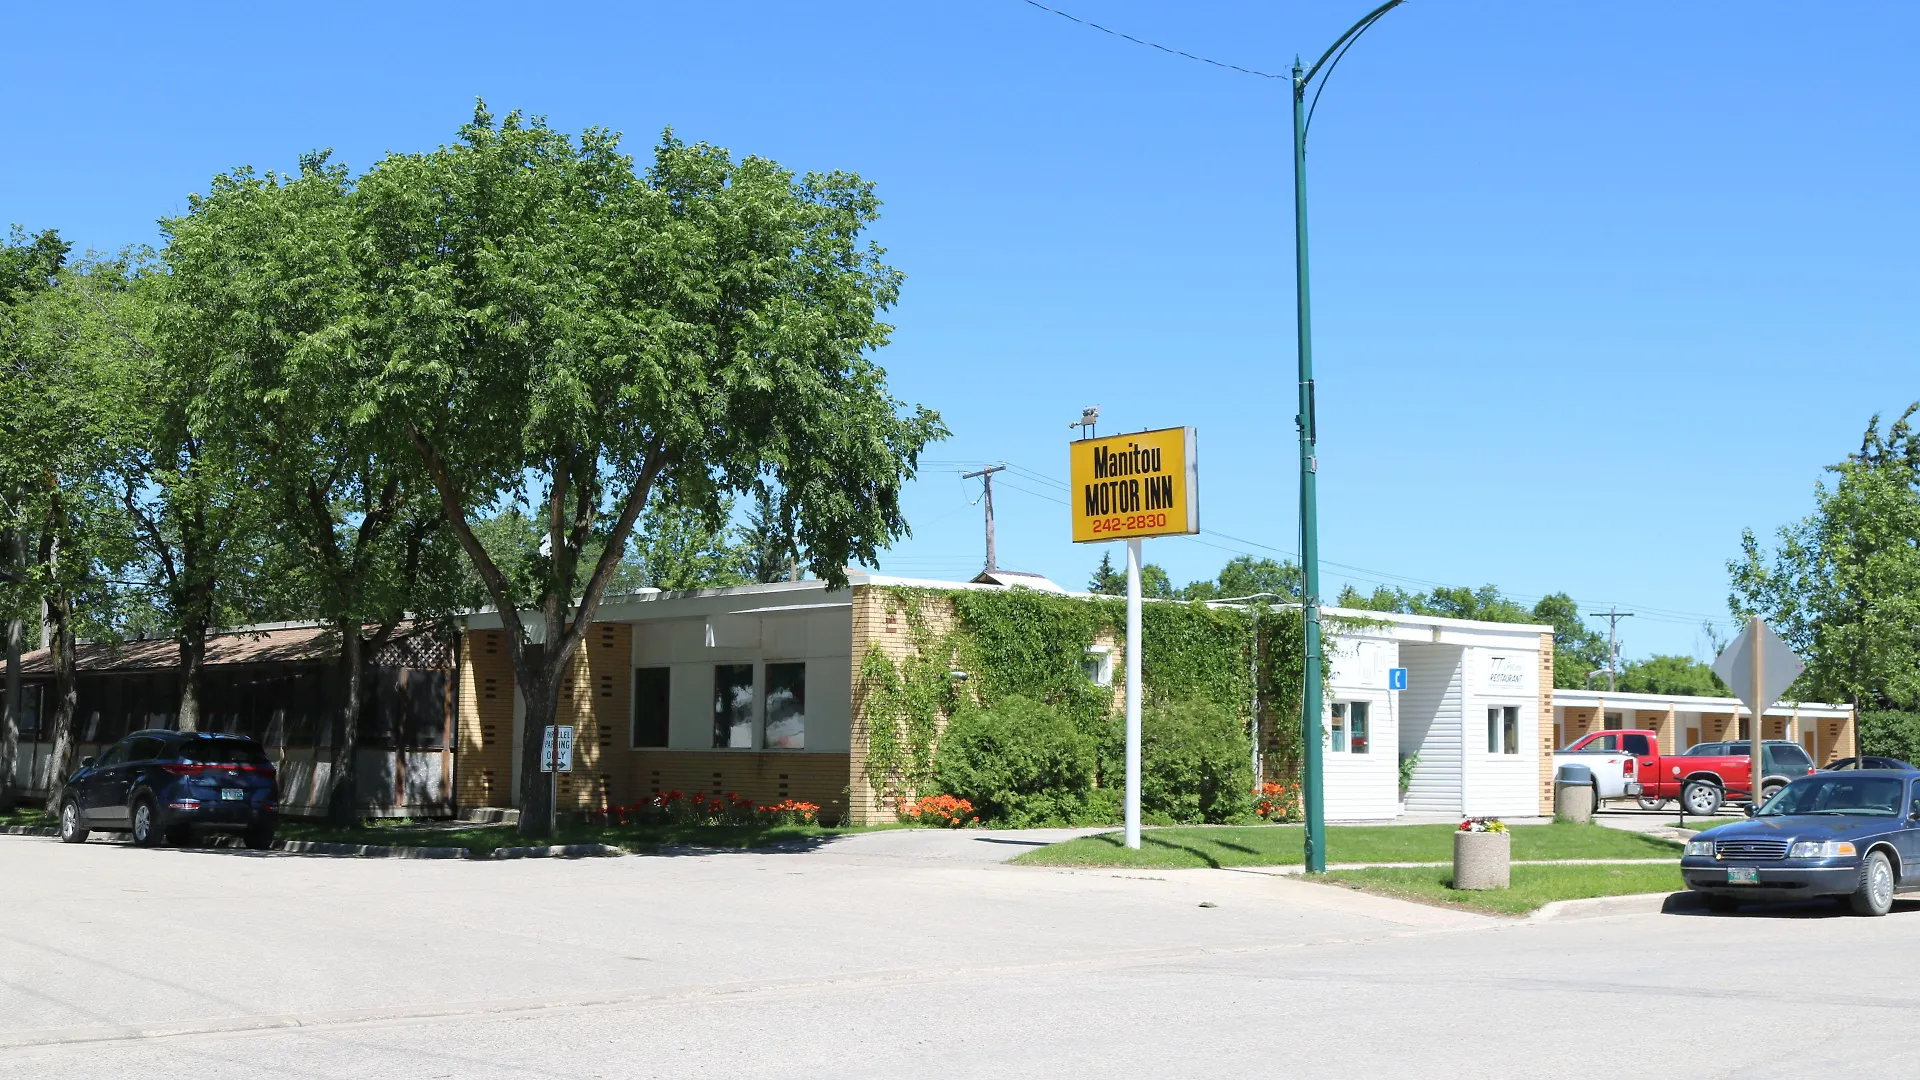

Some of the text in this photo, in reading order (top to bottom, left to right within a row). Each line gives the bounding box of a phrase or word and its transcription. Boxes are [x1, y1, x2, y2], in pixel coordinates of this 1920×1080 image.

[1094, 442, 1161, 479] Manitou
[1085, 475, 1173, 516] MOTOR INN
[1093, 513, 1166, 533] 242-2830
[1490, 673, 1523, 683] RESTAURANT
[544, 740, 570, 749] PARING
[546, 750, 566, 760] OLY
